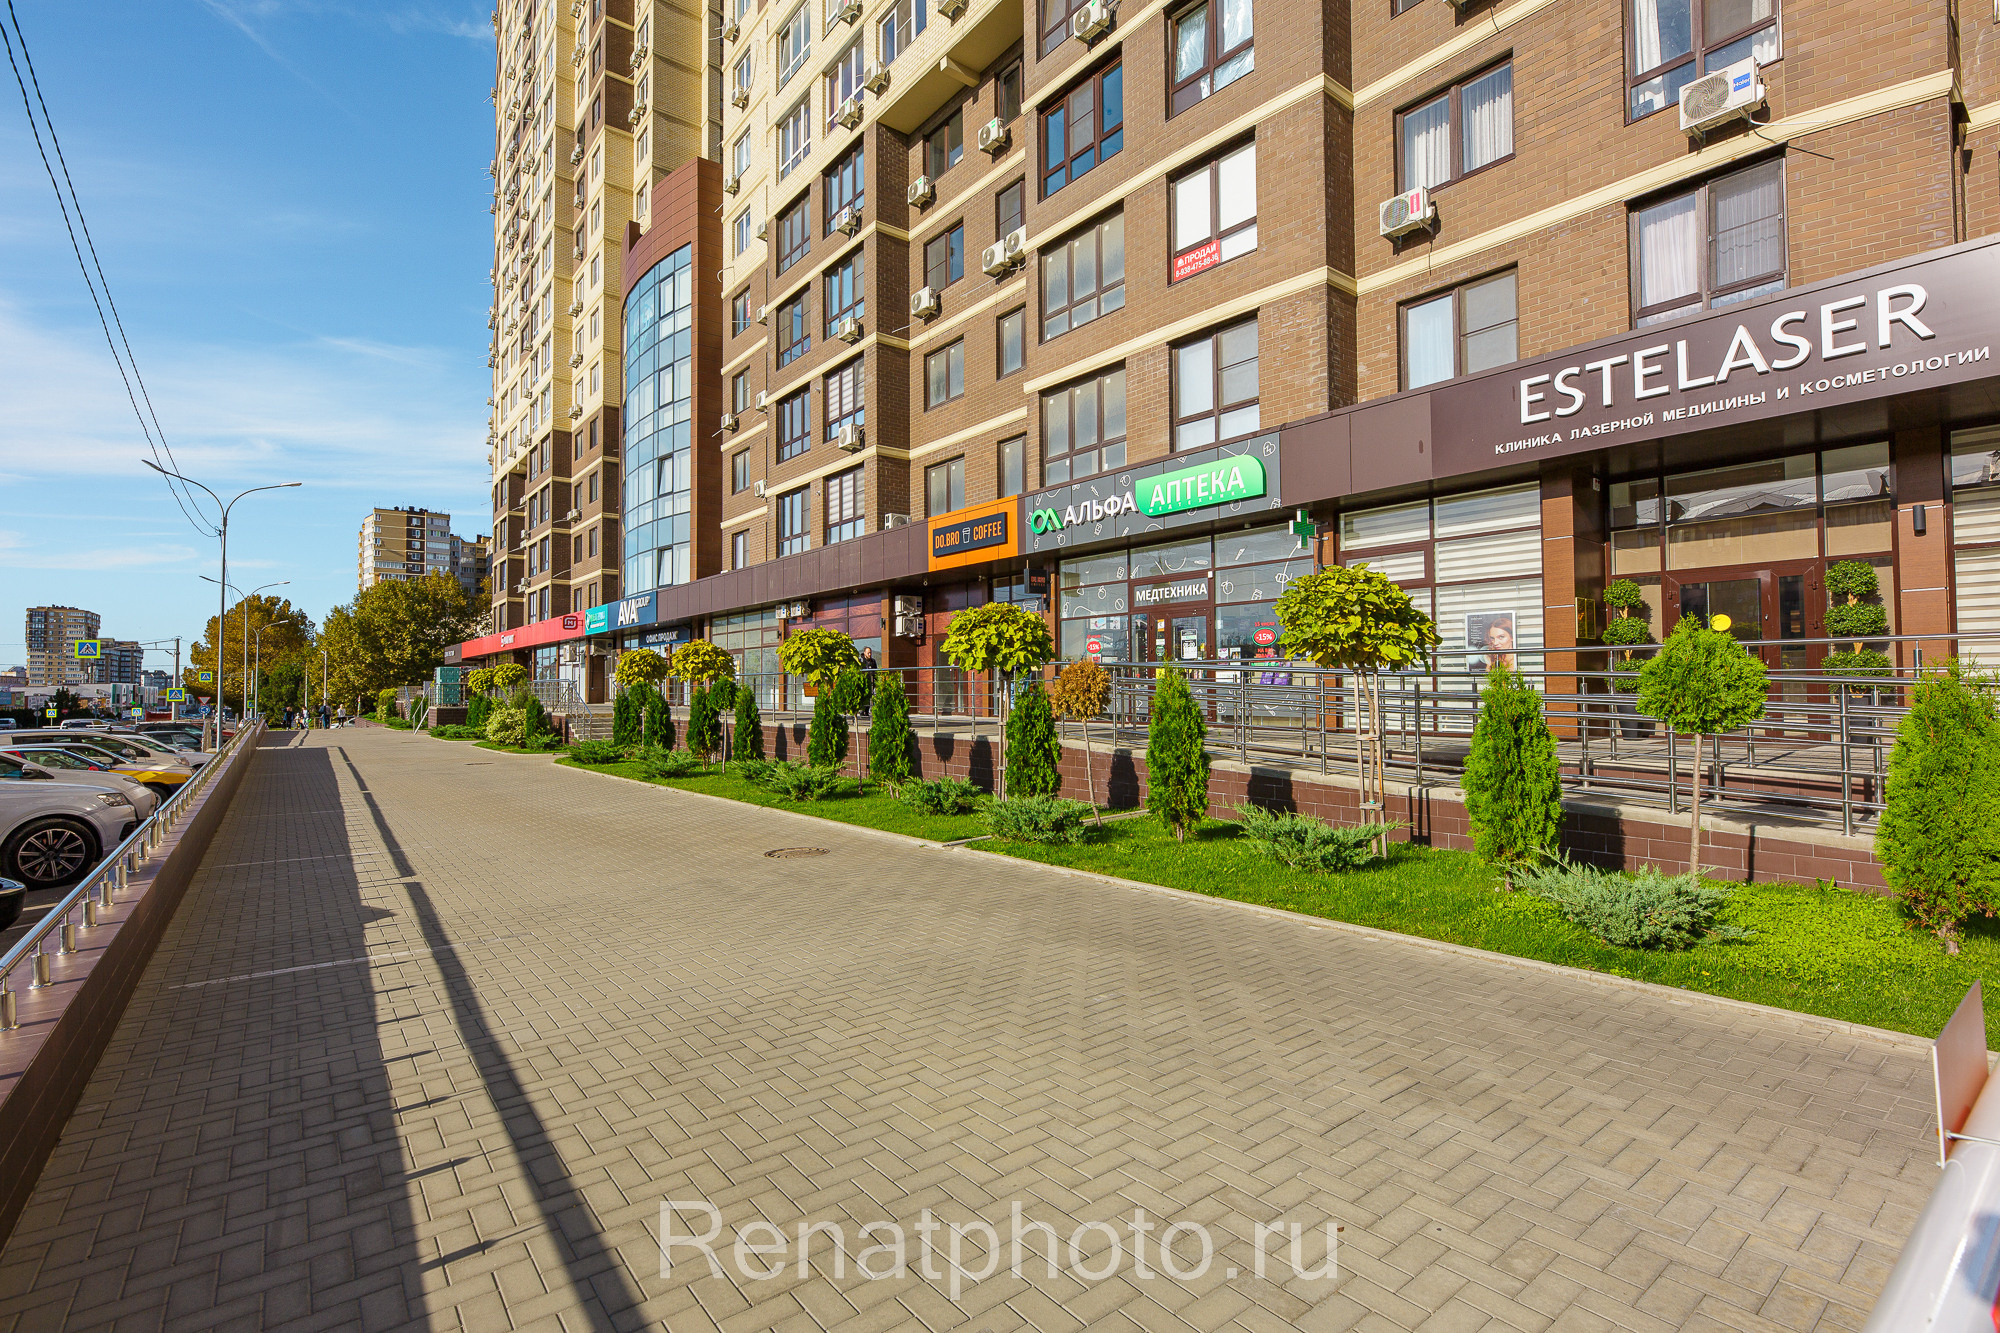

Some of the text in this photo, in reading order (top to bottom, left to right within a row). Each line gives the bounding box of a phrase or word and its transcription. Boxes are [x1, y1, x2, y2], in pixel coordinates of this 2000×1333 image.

[1519, 283, 1936, 425] ESTELASER
[1495, 346, 1990, 455] КЛИНИКА ЛАЗЕРНОЙ МЕДИЦИНЫ И КОСМЕТОЛОГИИ
[1062, 466, 1245, 527] АЛЬФА АПТЕКА
[973, 520, 1003, 541] COFFEE
[1135, 583, 1208, 603] МЕДТЕХНИКА
[617, 599, 640, 627] AVA
[645, 631, 678, 644] ОФИС ПРОДАЖ
[1255, 633, 1273, 641] -15%
